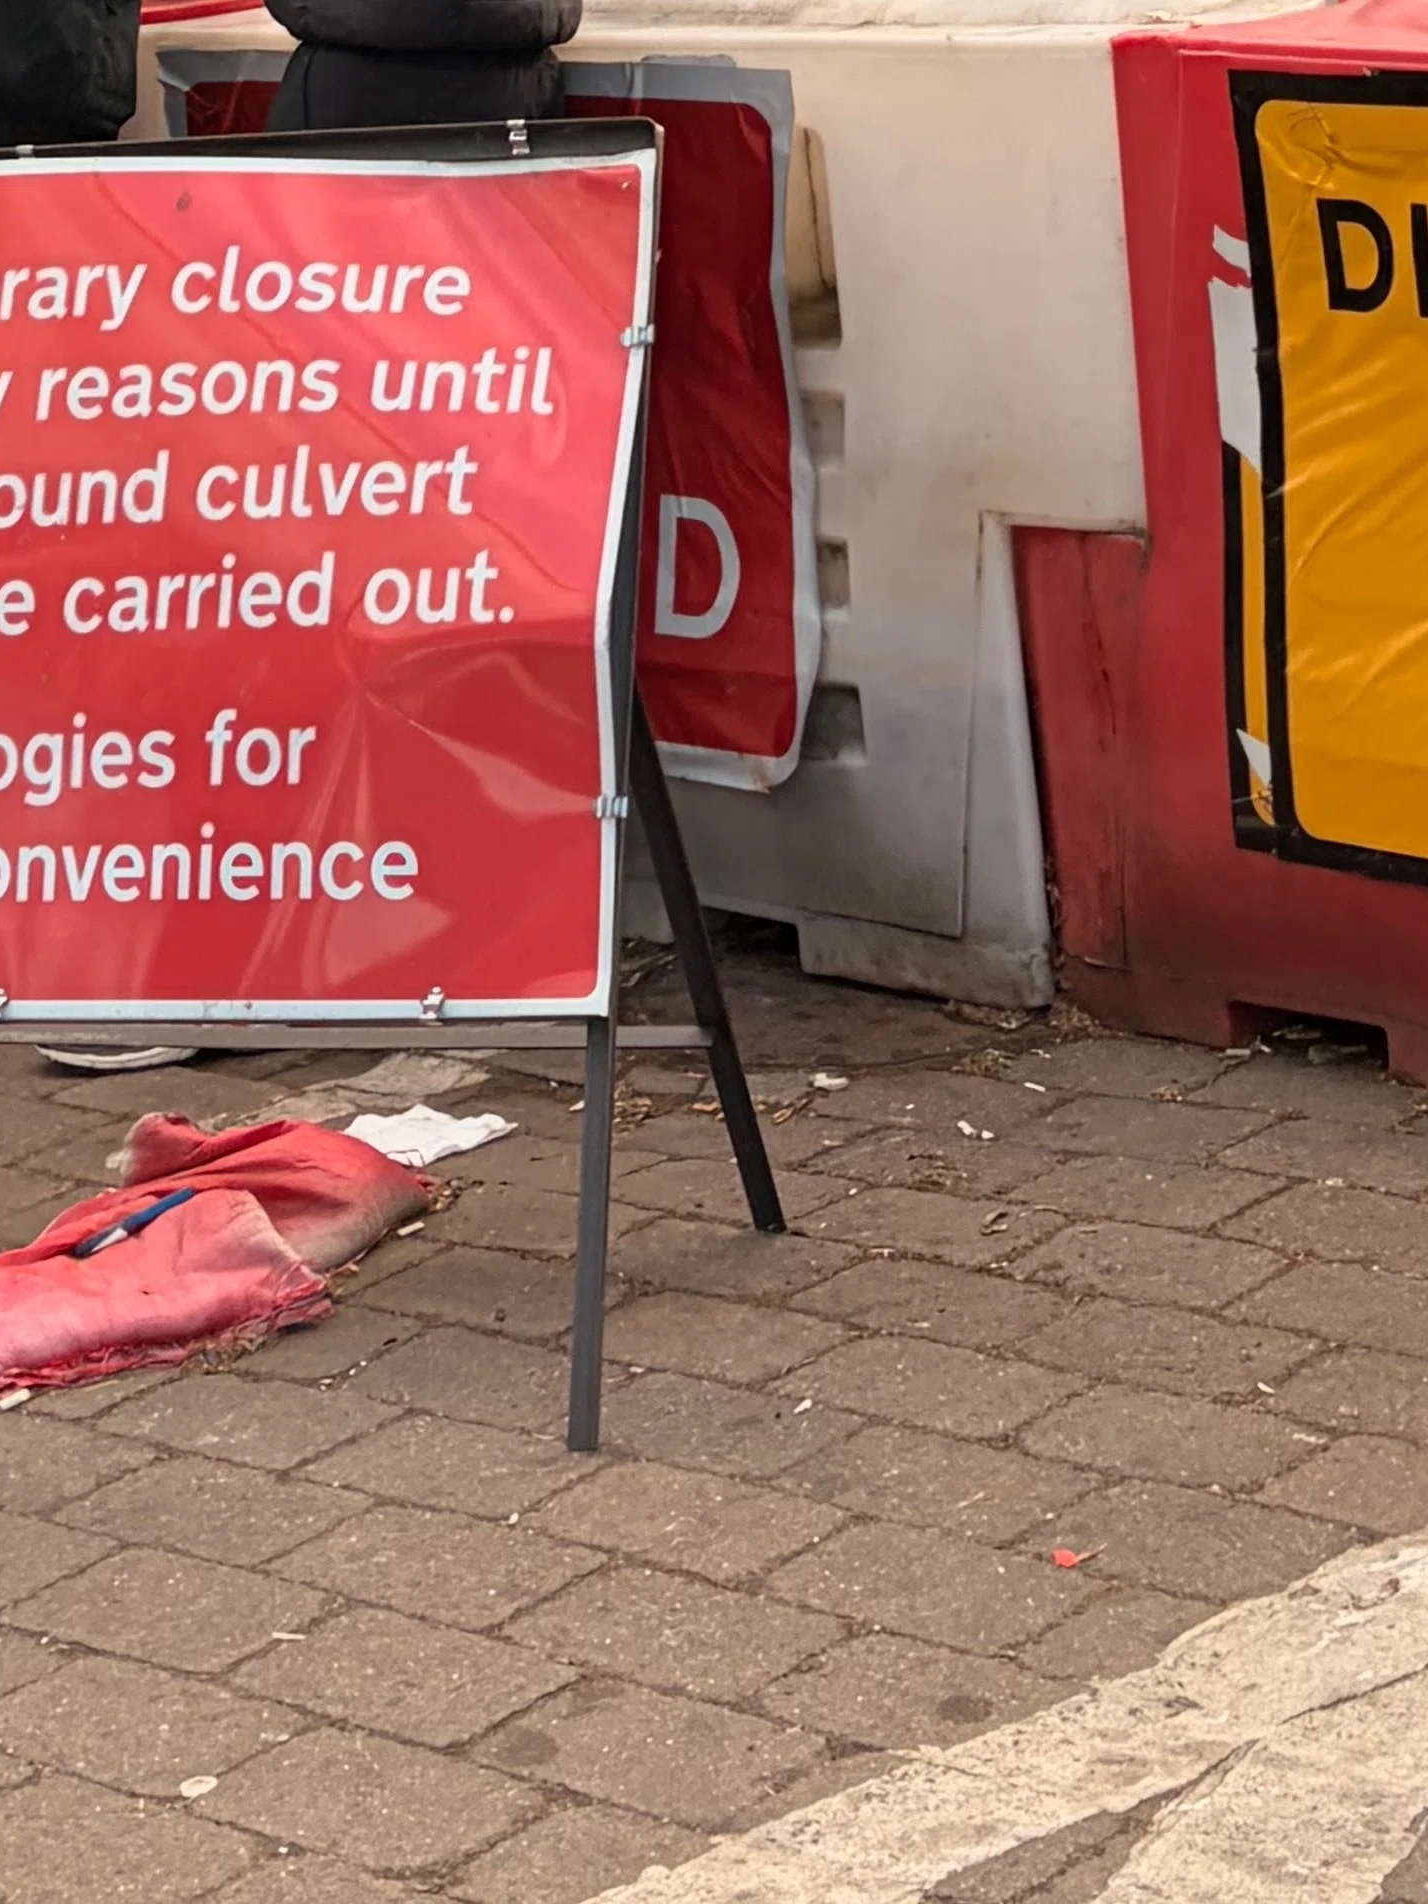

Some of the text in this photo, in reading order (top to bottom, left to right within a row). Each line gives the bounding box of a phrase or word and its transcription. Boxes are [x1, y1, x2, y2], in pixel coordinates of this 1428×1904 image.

[171, 245, 471, 316] closure
[36, 359, 340, 421] reasons
[371, 346, 553, 415] until
[196, 445, 478, 521] culvert
[63, 551, 335, 634] carried
[364, 549, 514, 625] out.
[206, 709, 316, 786] for
